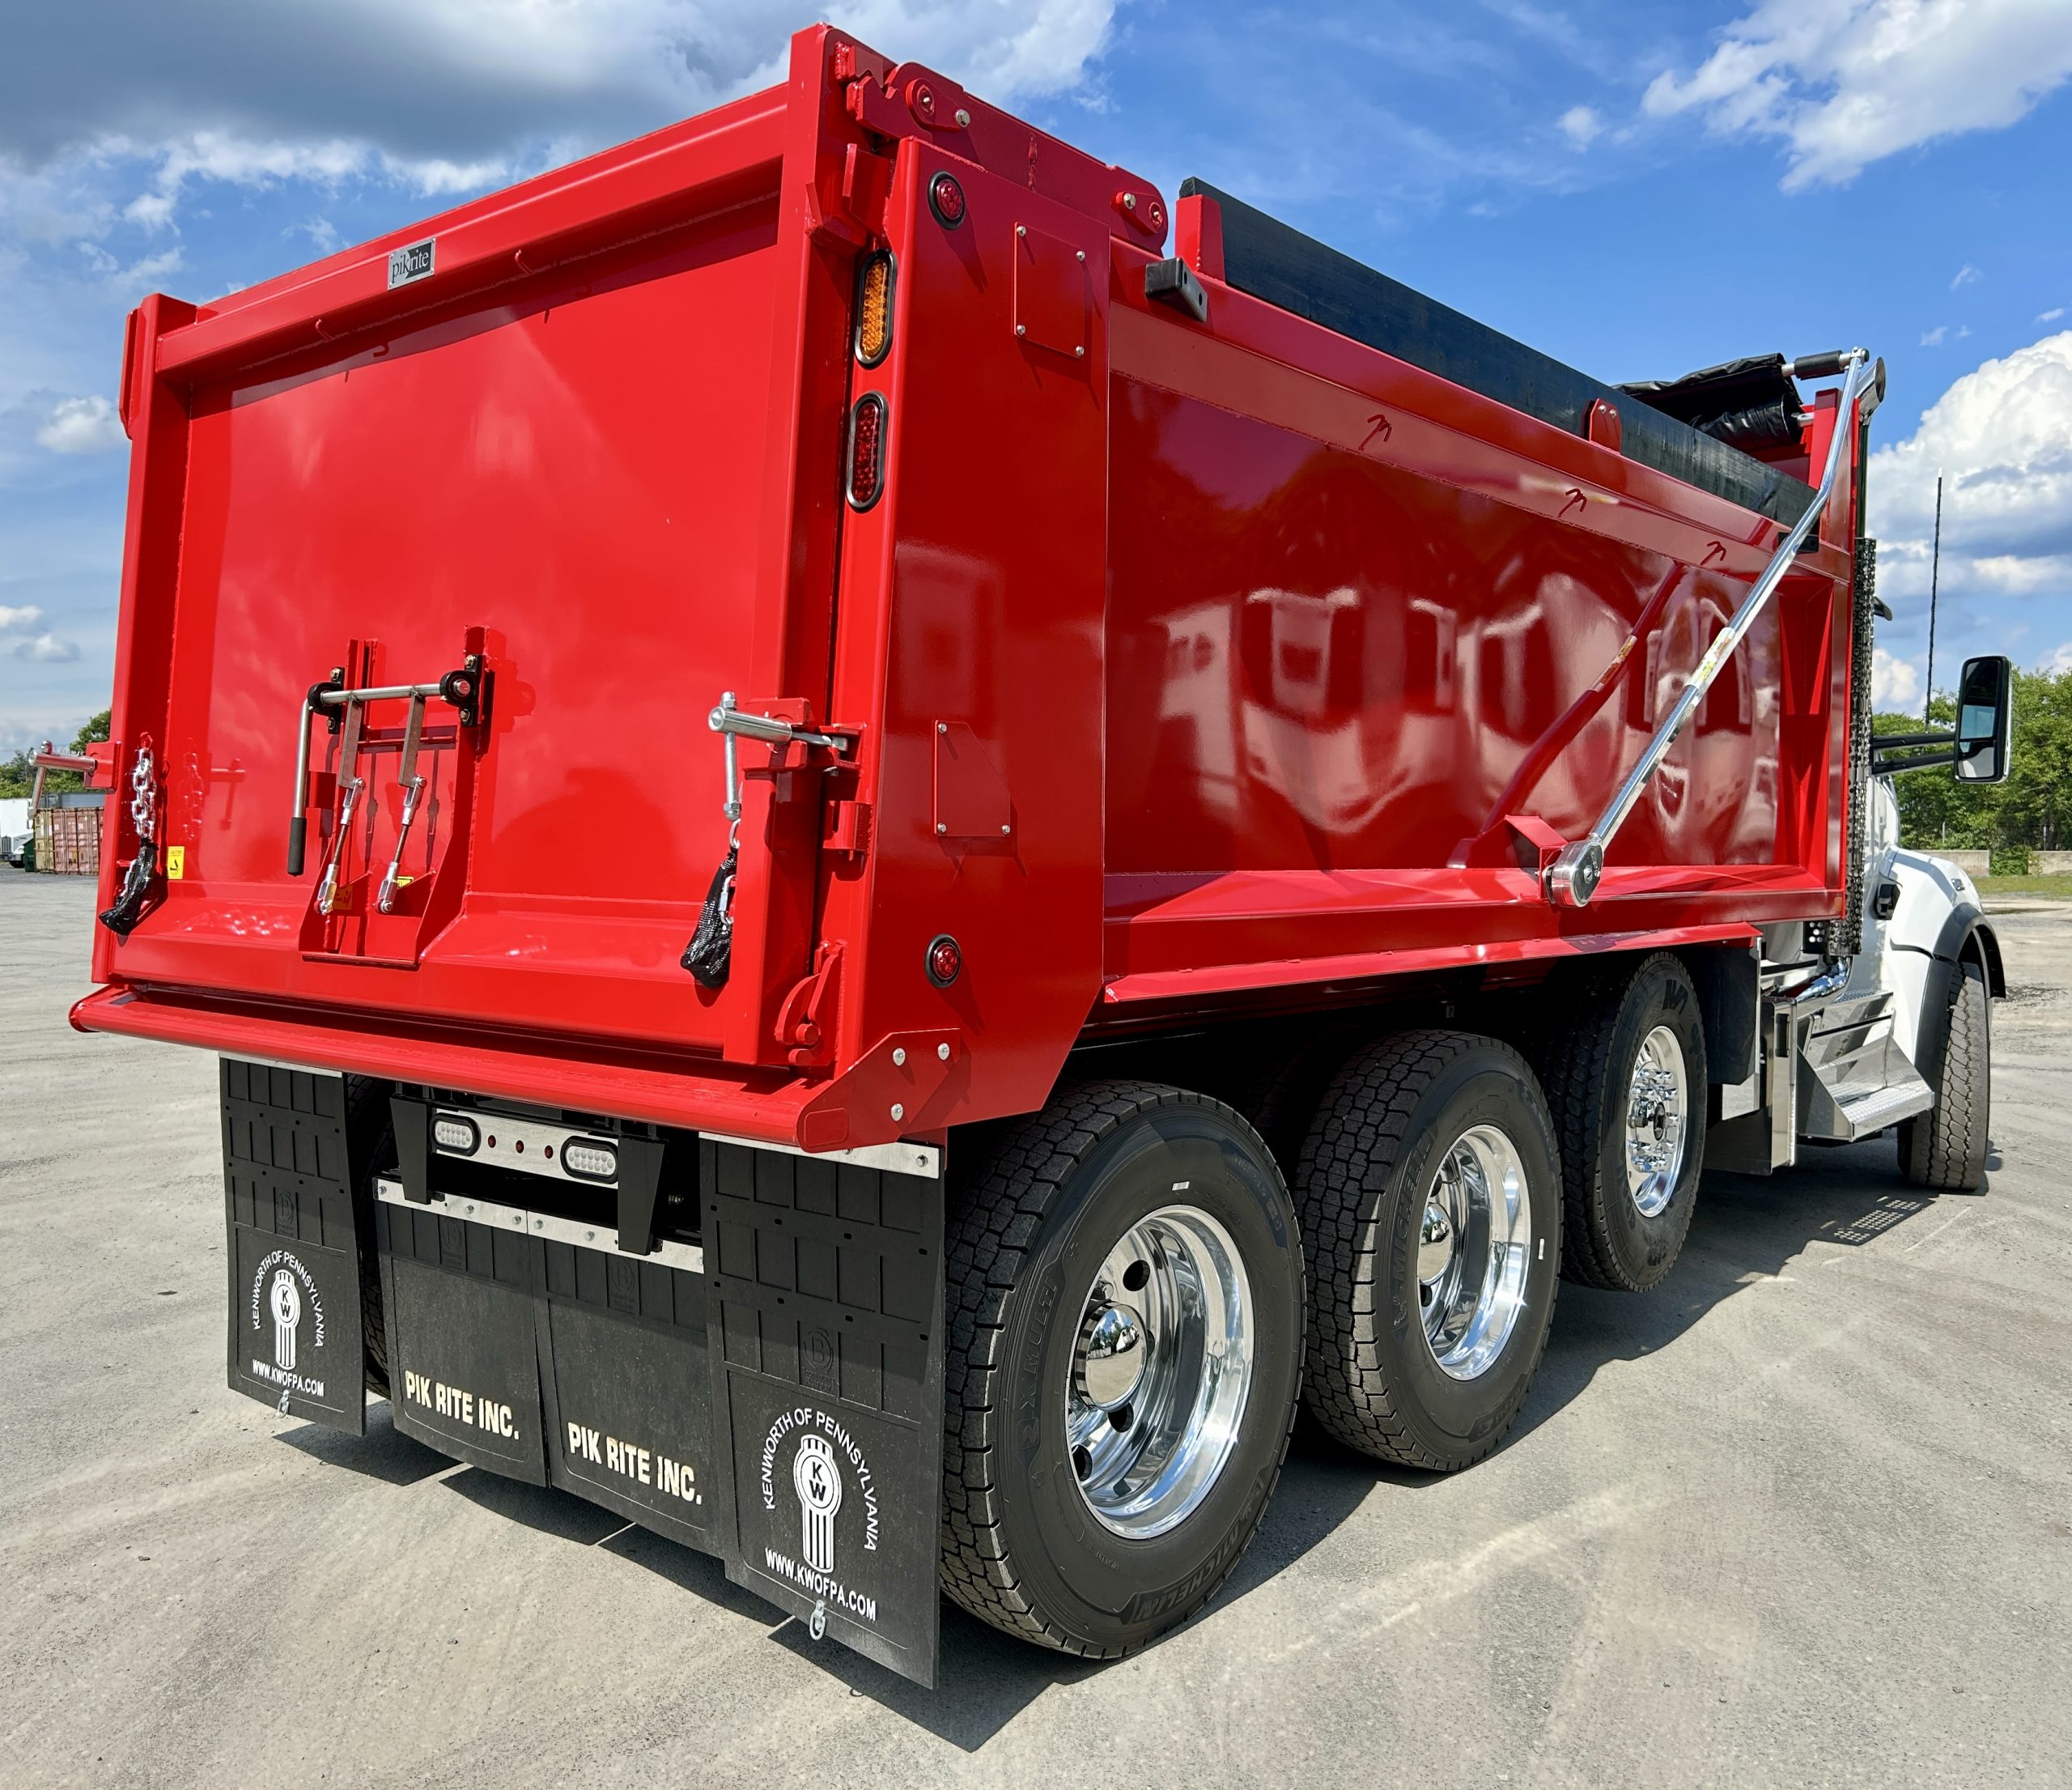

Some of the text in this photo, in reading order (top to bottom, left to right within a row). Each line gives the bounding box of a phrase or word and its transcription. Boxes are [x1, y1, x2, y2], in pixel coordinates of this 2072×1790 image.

[1392, 1134, 1431, 1282] MICHELIN
[252, 1256, 272, 1330] KENWORTH
[271, 1250, 284, 1264] OF
[283, 1252, 325, 1347] PENNSYLVANIA
[253, 1358, 325, 1397] WWW.KWOFPA.COM
[405, 1370, 520, 1440] PIK RITE INC.
[567, 1422, 703, 1505] PIK RITE INC.
[761, 1407, 881, 1551] KENWORTH OF PENNSYLVANIA
[809, 1481, 826, 1502] W
[812, 1460, 822, 1480] K
[765, 1547, 877, 1622] WWW.KWOFPA.COM
[1134, 1524, 1240, 1621] MICHELIN
